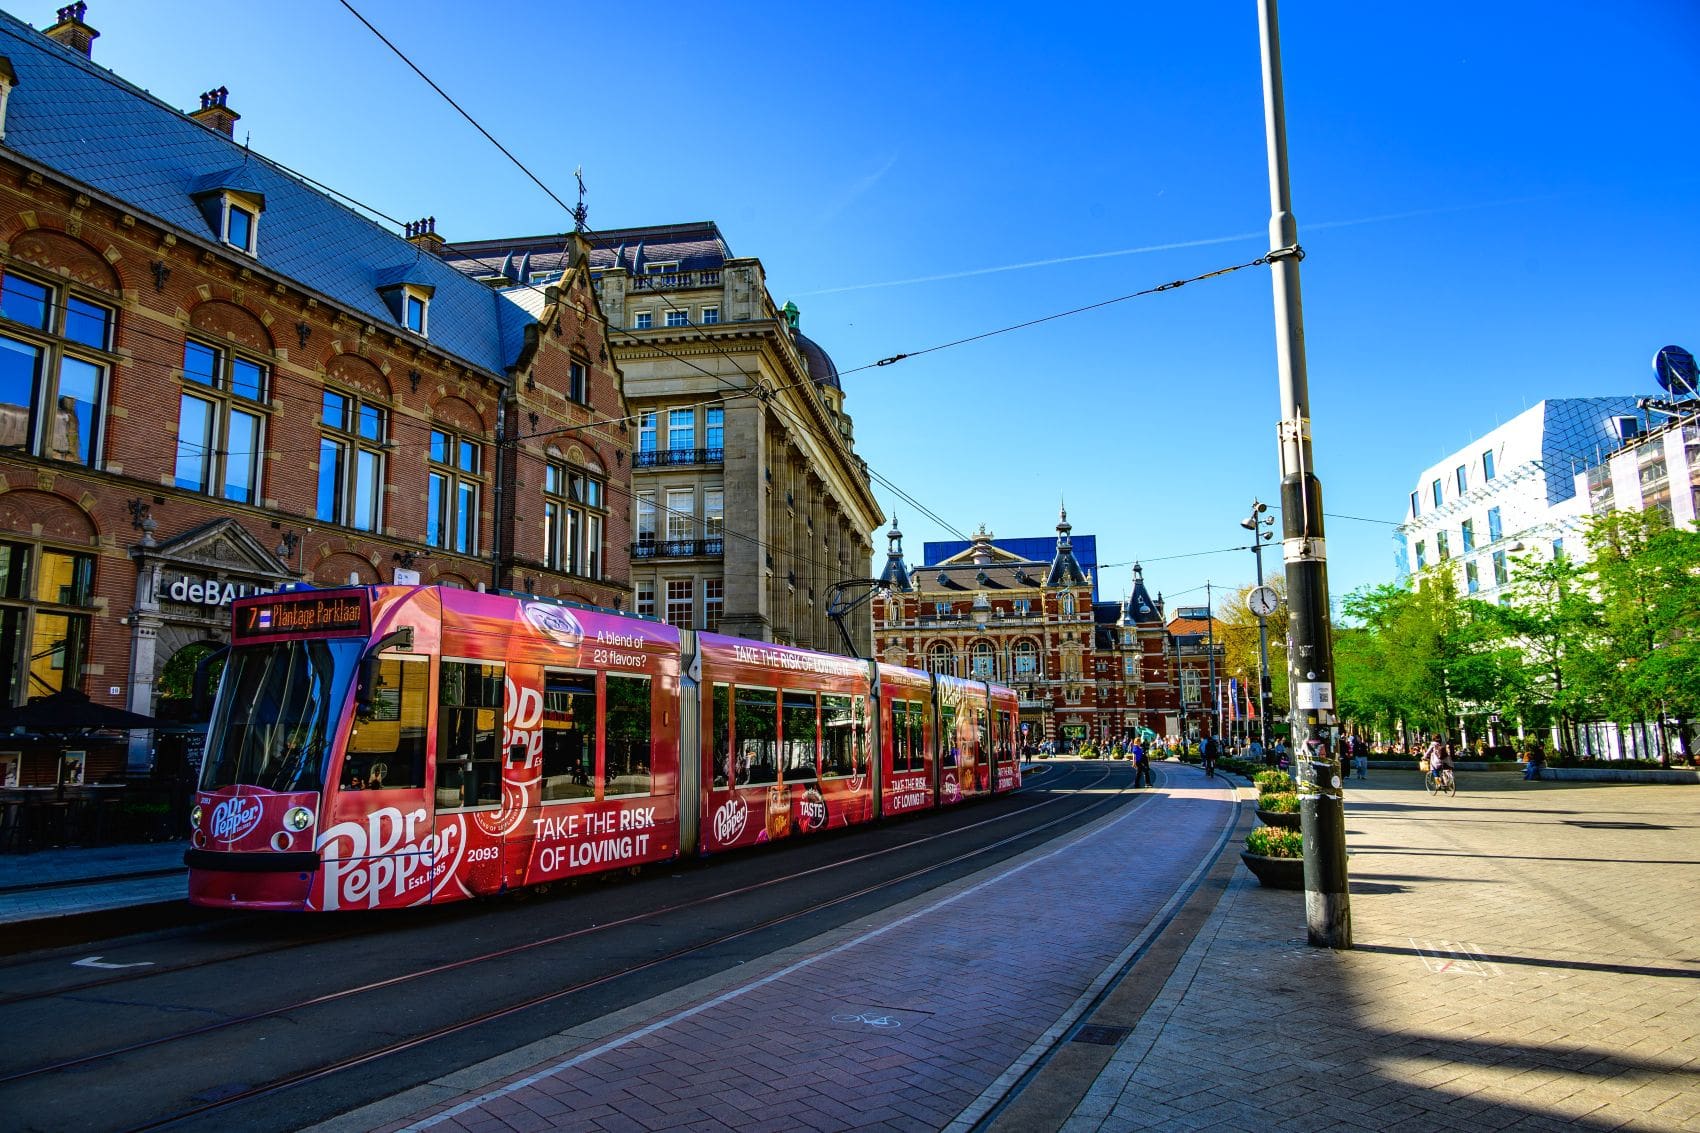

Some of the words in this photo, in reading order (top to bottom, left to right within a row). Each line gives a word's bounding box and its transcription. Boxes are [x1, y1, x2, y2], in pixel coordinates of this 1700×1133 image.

[248, 607, 257, 629] 7
[272, 604, 315, 629] Plantage
[317, 599, 360, 623] Parklaan
[596, 630, 604, 643] A
[605, 630, 632, 648] blend
[634, 635, 644, 649] of
[593, 649, 607, 664] 23
[609, 650, 647, 667] flavors?
[733, 645, 760, 664] TAKE
[760, 649, 779, 667] THE
[780, 653, 800, 670] RISK
[802, 656, 814, 671] OF
[891, 779, 905, 793] TAKE
[905, 777, 915, 791] THE
[915, 776, 927, 789] RISK
[228, 797, 246, 817] Dr
[726, 799, 738, 820] Dr
[800, 801, 823, 818] TASTE
[893, 795, 902, 810] OF
[213, 802, 258, 838] Pepper
[533, 815, 579, 842] TAKE
[583, 810, 616, 836] THE
[620, 806, 656, 831] RISK
[717, 805, 746, 842] Pepper
[367, 806, 427, 862] Dr
[467, 846, 499, 863] 2093
[540, 846, 566, 872] OF
[569, 836, 632, 868] LOVING
[635, 834, 650, 857] IT
[316, 820, 458, 911] Pepper
